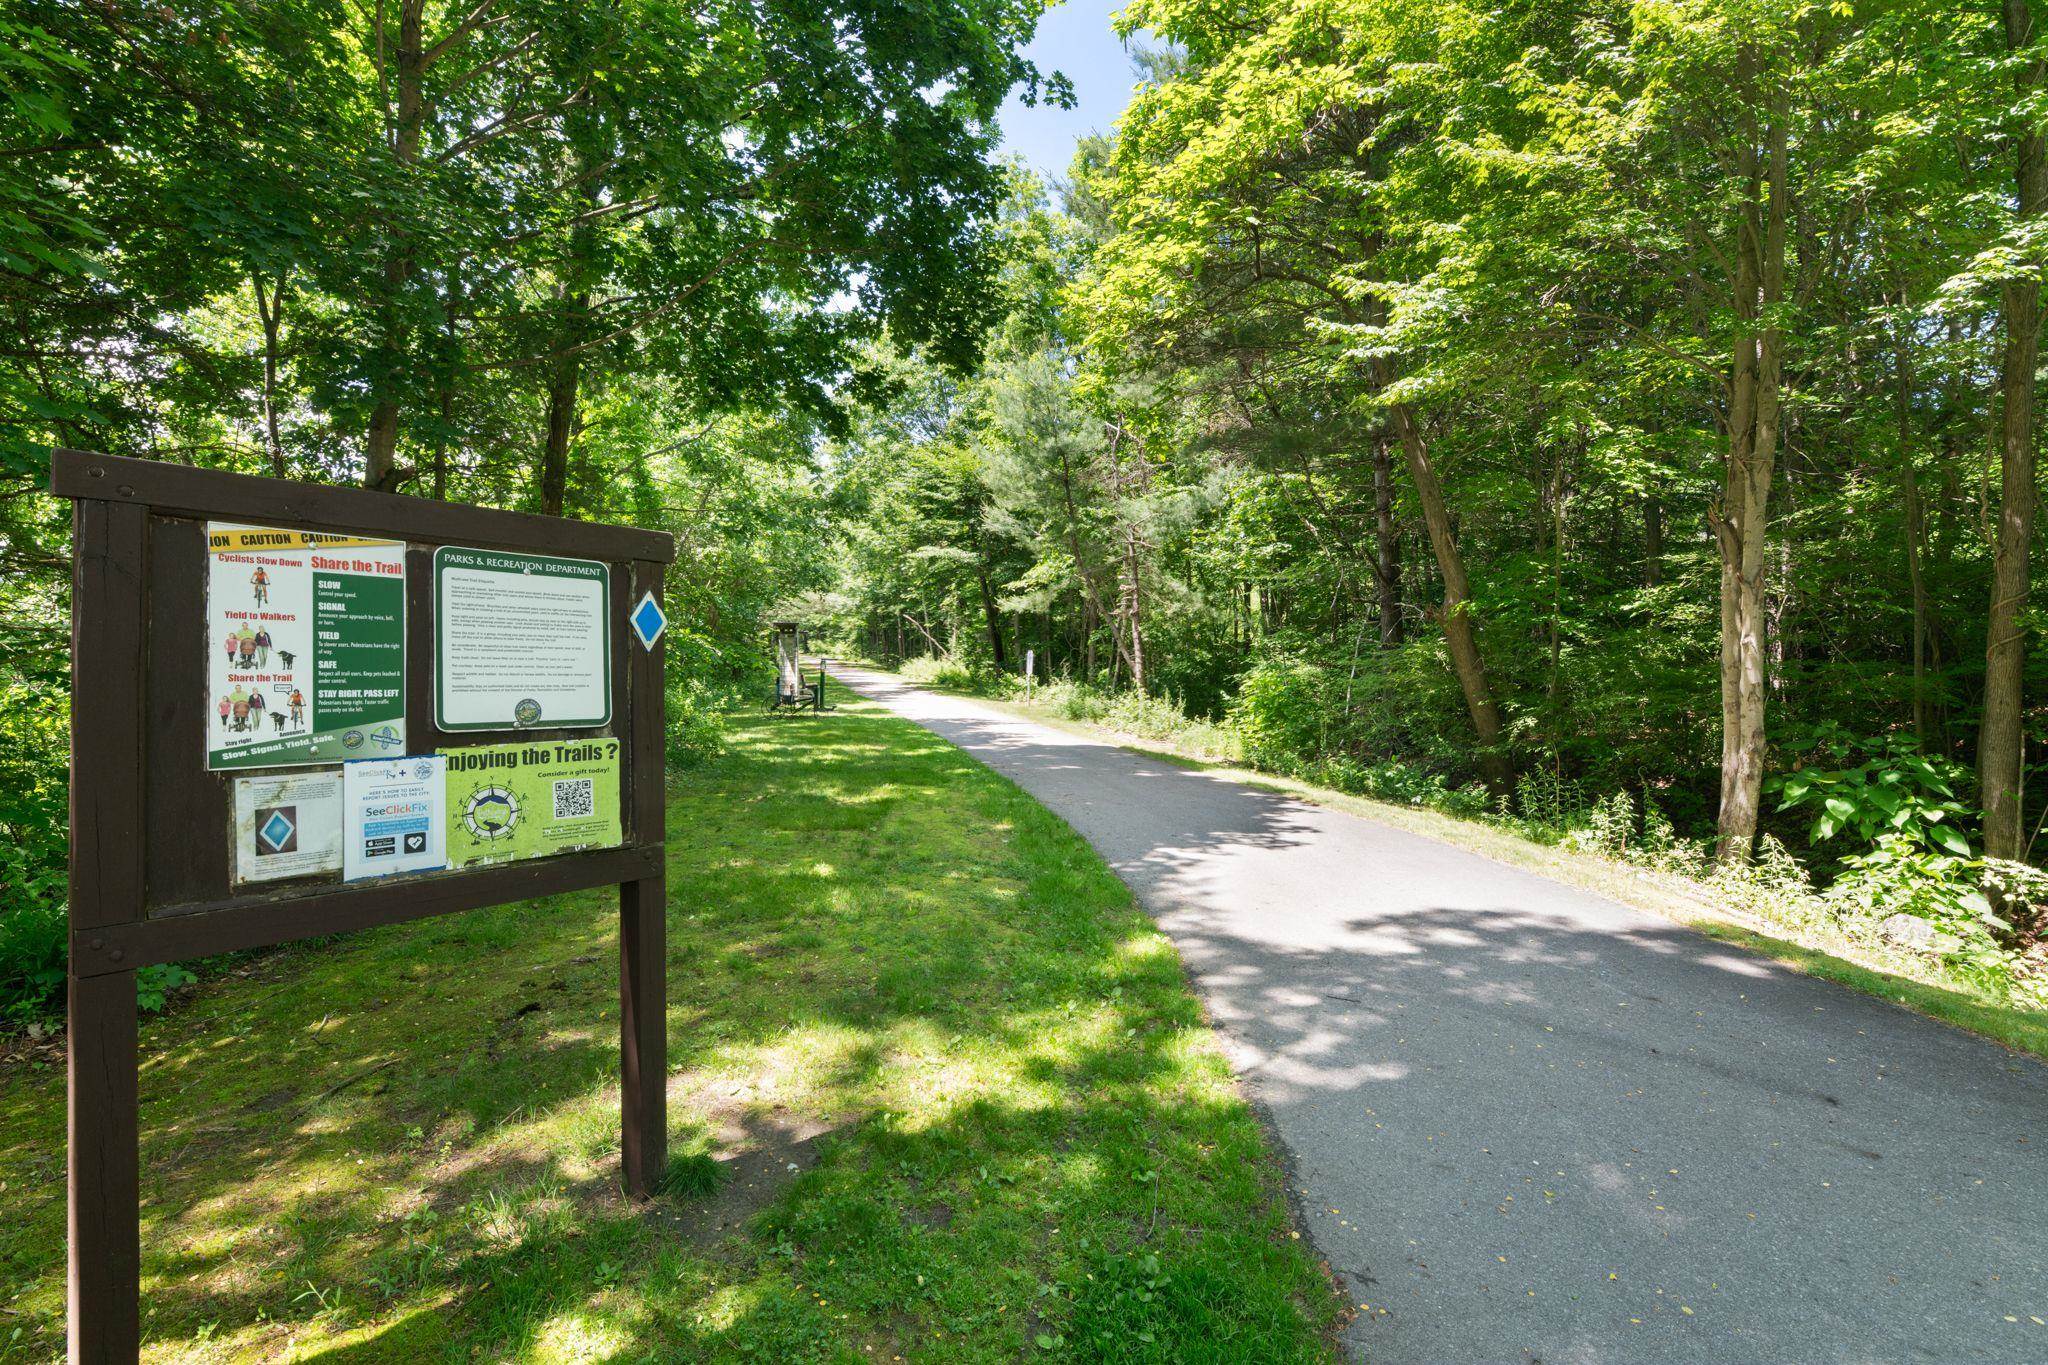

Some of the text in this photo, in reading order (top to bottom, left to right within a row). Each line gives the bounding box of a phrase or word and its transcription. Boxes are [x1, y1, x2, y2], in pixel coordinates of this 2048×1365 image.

[241, 534, 292, 546] CAUTION
[218, 553, 303, 567] Cyclists Slow Down
[444, 553, 601, 576] PARKS & RECREATION DEPARTMENT
[311, 556, 402, 575] Share the Trail
[318, 580, 341, 590] SLOW
[318, 602, 346, 611] SIGNAL
[224, 611, 296, 621] Yield to Walkers
[318, 631, 340, 640] YIELD
[318, 660, 338, 669] SAFE
[228, 674, 293, 682] Share the Trail
[318, 689, 400, 698] STAY RIGHT, PASS LEFT
[279, 729, 306, 738] Announce
[238, 737, 252, 746] right
[222, 751, 250, 761] Slow.
[250, 743, 285, 756] Signal.
[286, 739, 312, 750] Yield.
[312, 734, 336, 744] Safe.
[445, 751, 518, 772] njoying
[521, 748, 551, 765] the
[554, 744, 603, 763] Trails
[605, 743, 618, 760] ?
[537, 770, 568, 778] Consider
[575, 768, 588, 776] gift
[588, 767, 610, 775] today!
[366, 802, 428, 817] SeeClickFix
